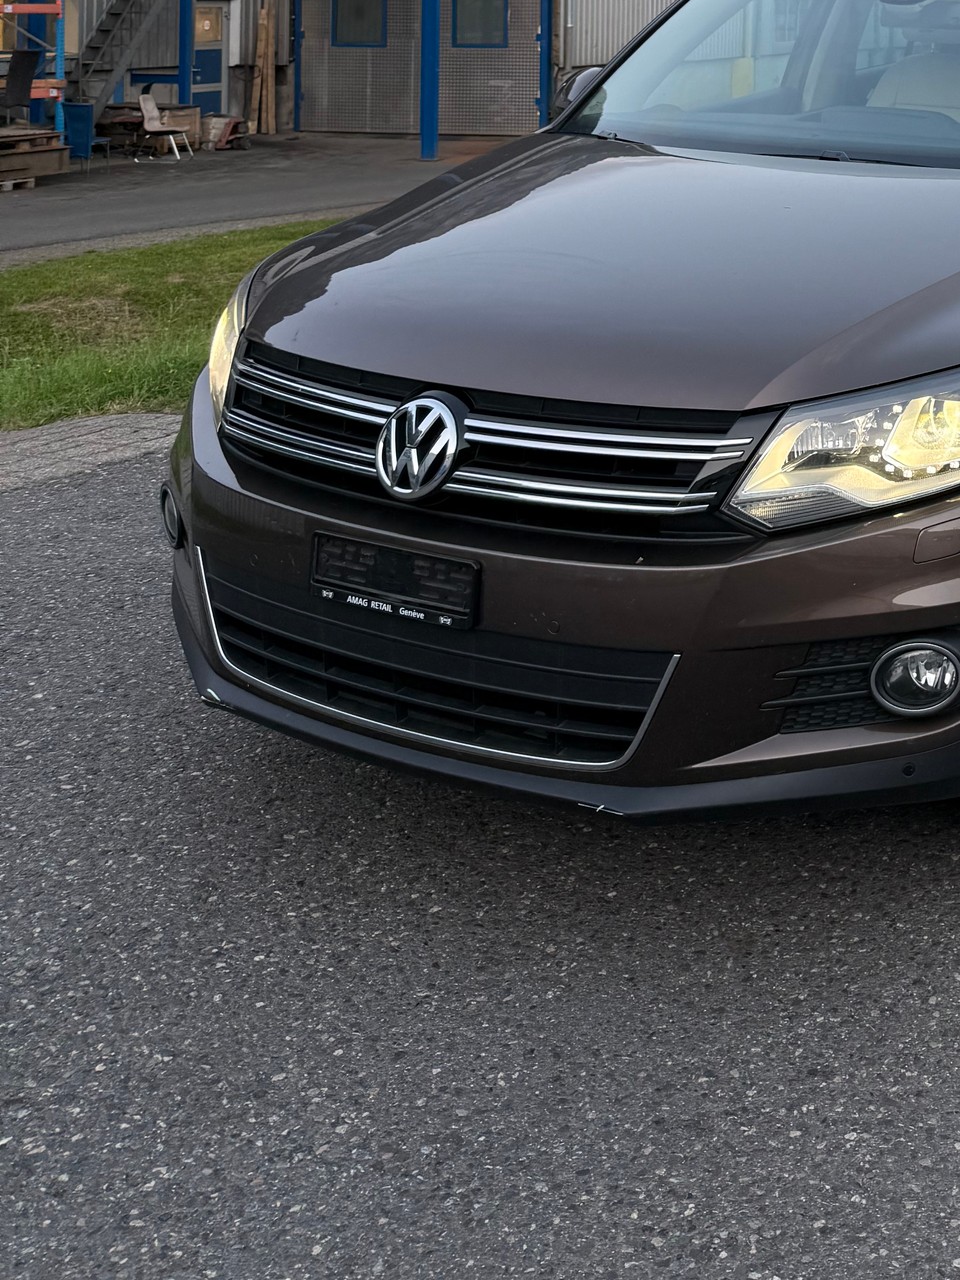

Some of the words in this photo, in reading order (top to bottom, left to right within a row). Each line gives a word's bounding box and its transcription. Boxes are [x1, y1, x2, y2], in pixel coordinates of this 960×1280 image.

[381, 401, 455, 496] VW
[347, 595, 368, 607] AMAG
[370, 600, 393, 613] RETAIL
[399, 607, 425, 620] Genève
